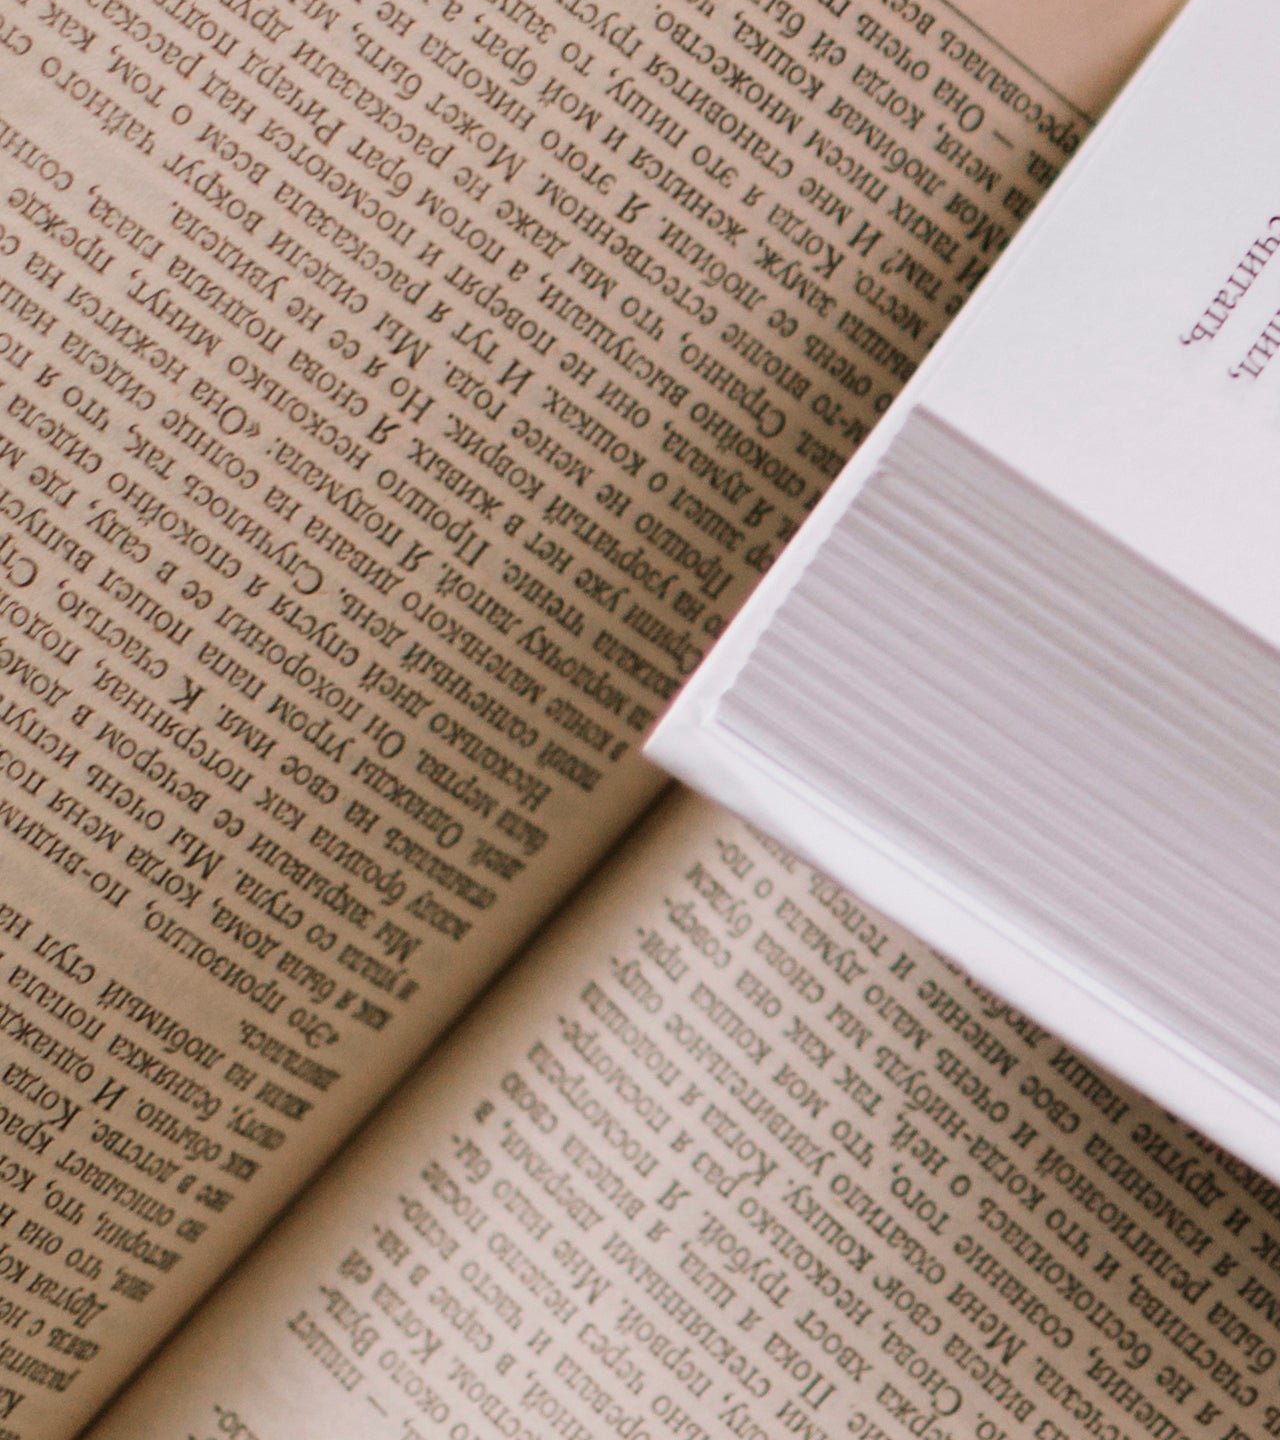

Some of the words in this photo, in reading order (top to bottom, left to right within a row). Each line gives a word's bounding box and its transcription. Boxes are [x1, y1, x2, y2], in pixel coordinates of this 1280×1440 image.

[731, 9, 827, 103] кошка,
[640, 51, 796, 180] становится
[824, 94, 948, 198] любимая
[796, 175, 854, 228] мне
[180, 472, 325, 597] Случилось
[398, 640, 540, 749] солнечный
